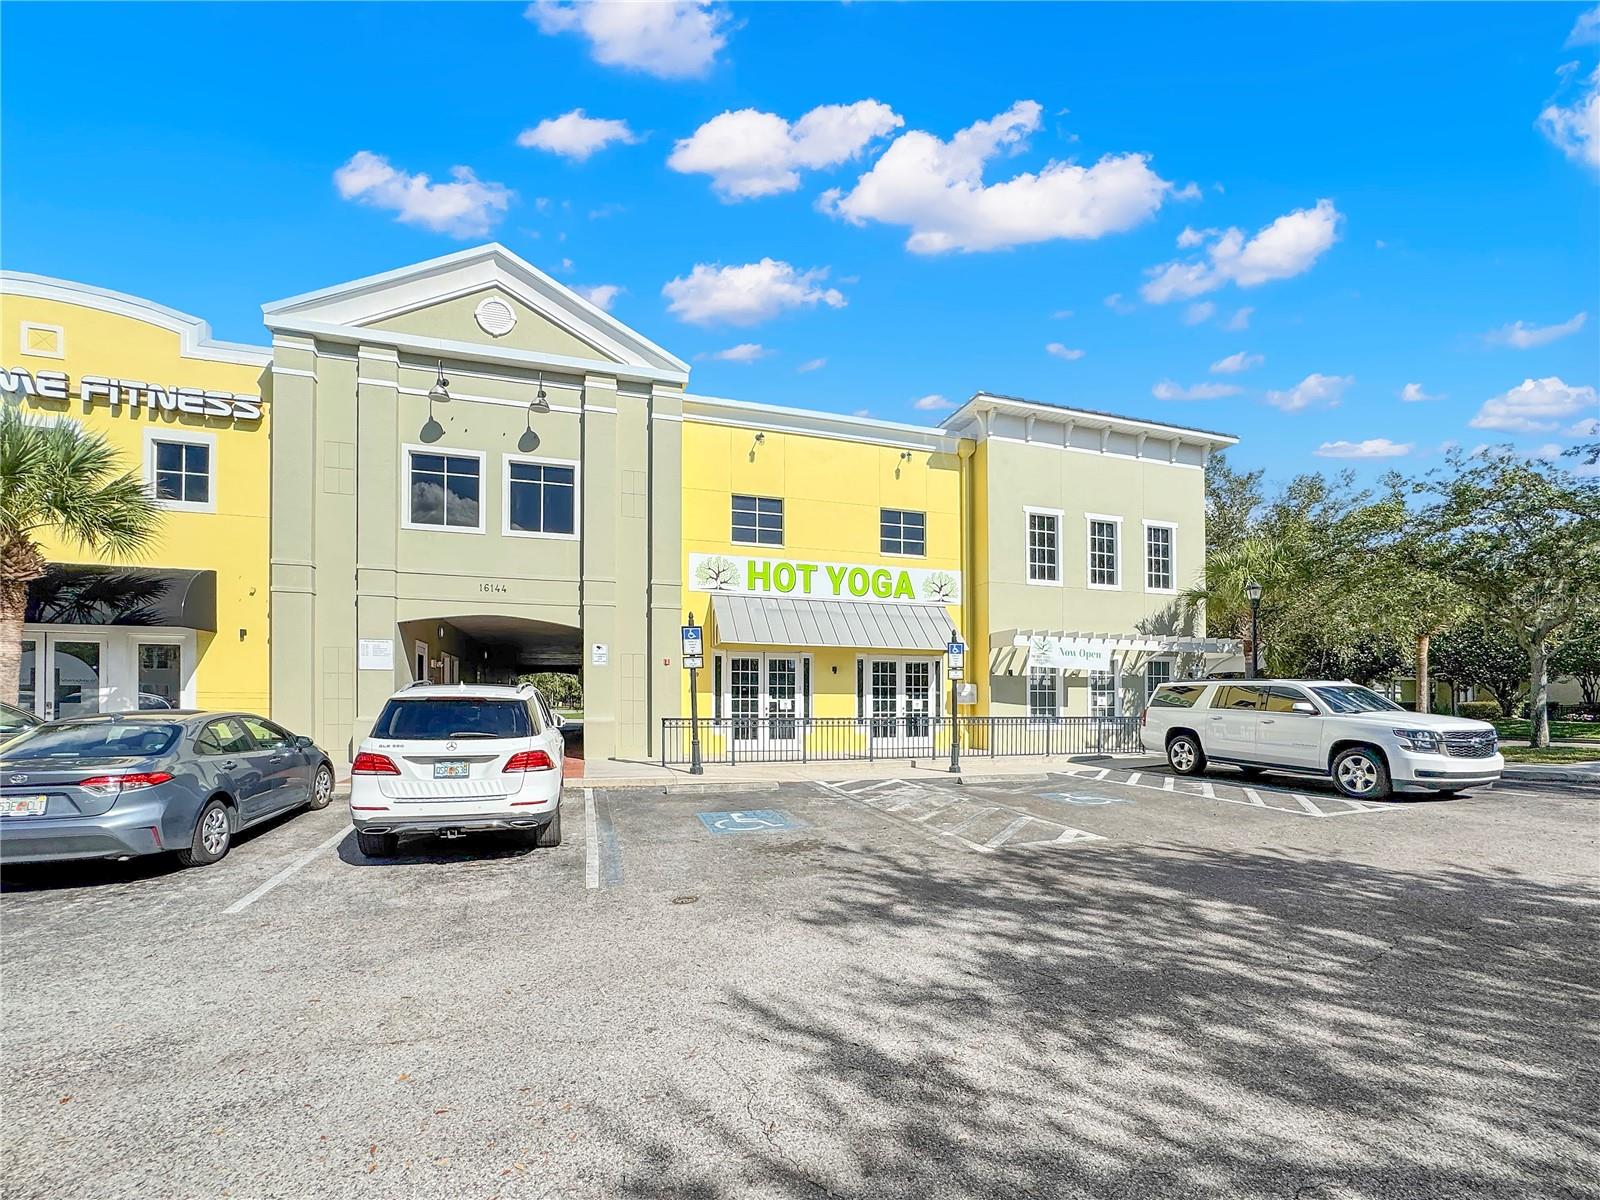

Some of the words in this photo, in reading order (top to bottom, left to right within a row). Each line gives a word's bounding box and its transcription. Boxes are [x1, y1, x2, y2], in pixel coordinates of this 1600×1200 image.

[81, 375, 264, 421] FITNESS
[479, 583, 507, 593] 16144
[747, 559, 818, 593] HOT
[825, 565, 916, 600] YOGA
[1059, 647, 1076, 657] Now
[1079, 648, 1102, 661] Open
